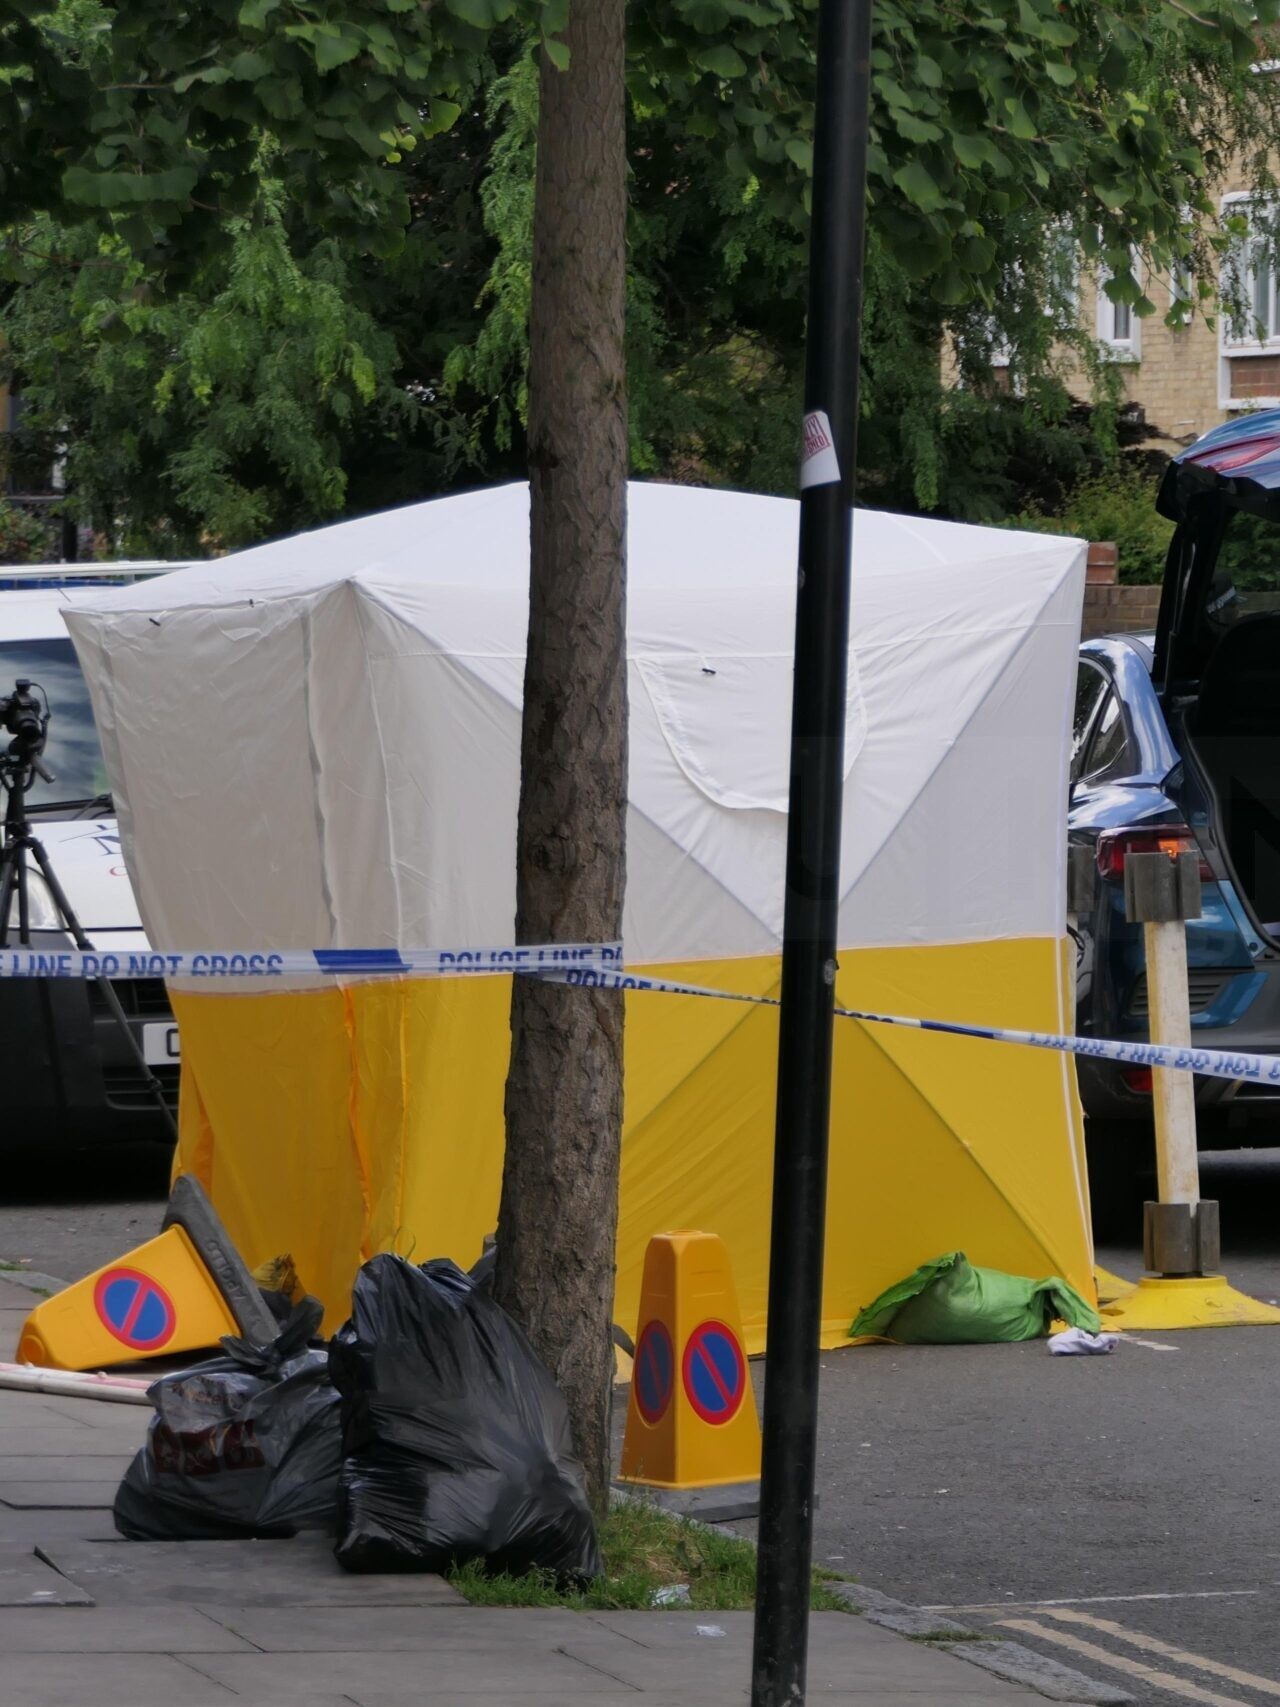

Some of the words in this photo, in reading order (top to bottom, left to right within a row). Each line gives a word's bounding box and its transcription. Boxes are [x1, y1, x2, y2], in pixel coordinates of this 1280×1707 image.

[12, 954, 72, 977] LINE
[81, 954, 119, 977] DO
[129, 954, 183, 977] NOT
[192, 953, 283, 977] CROSS
